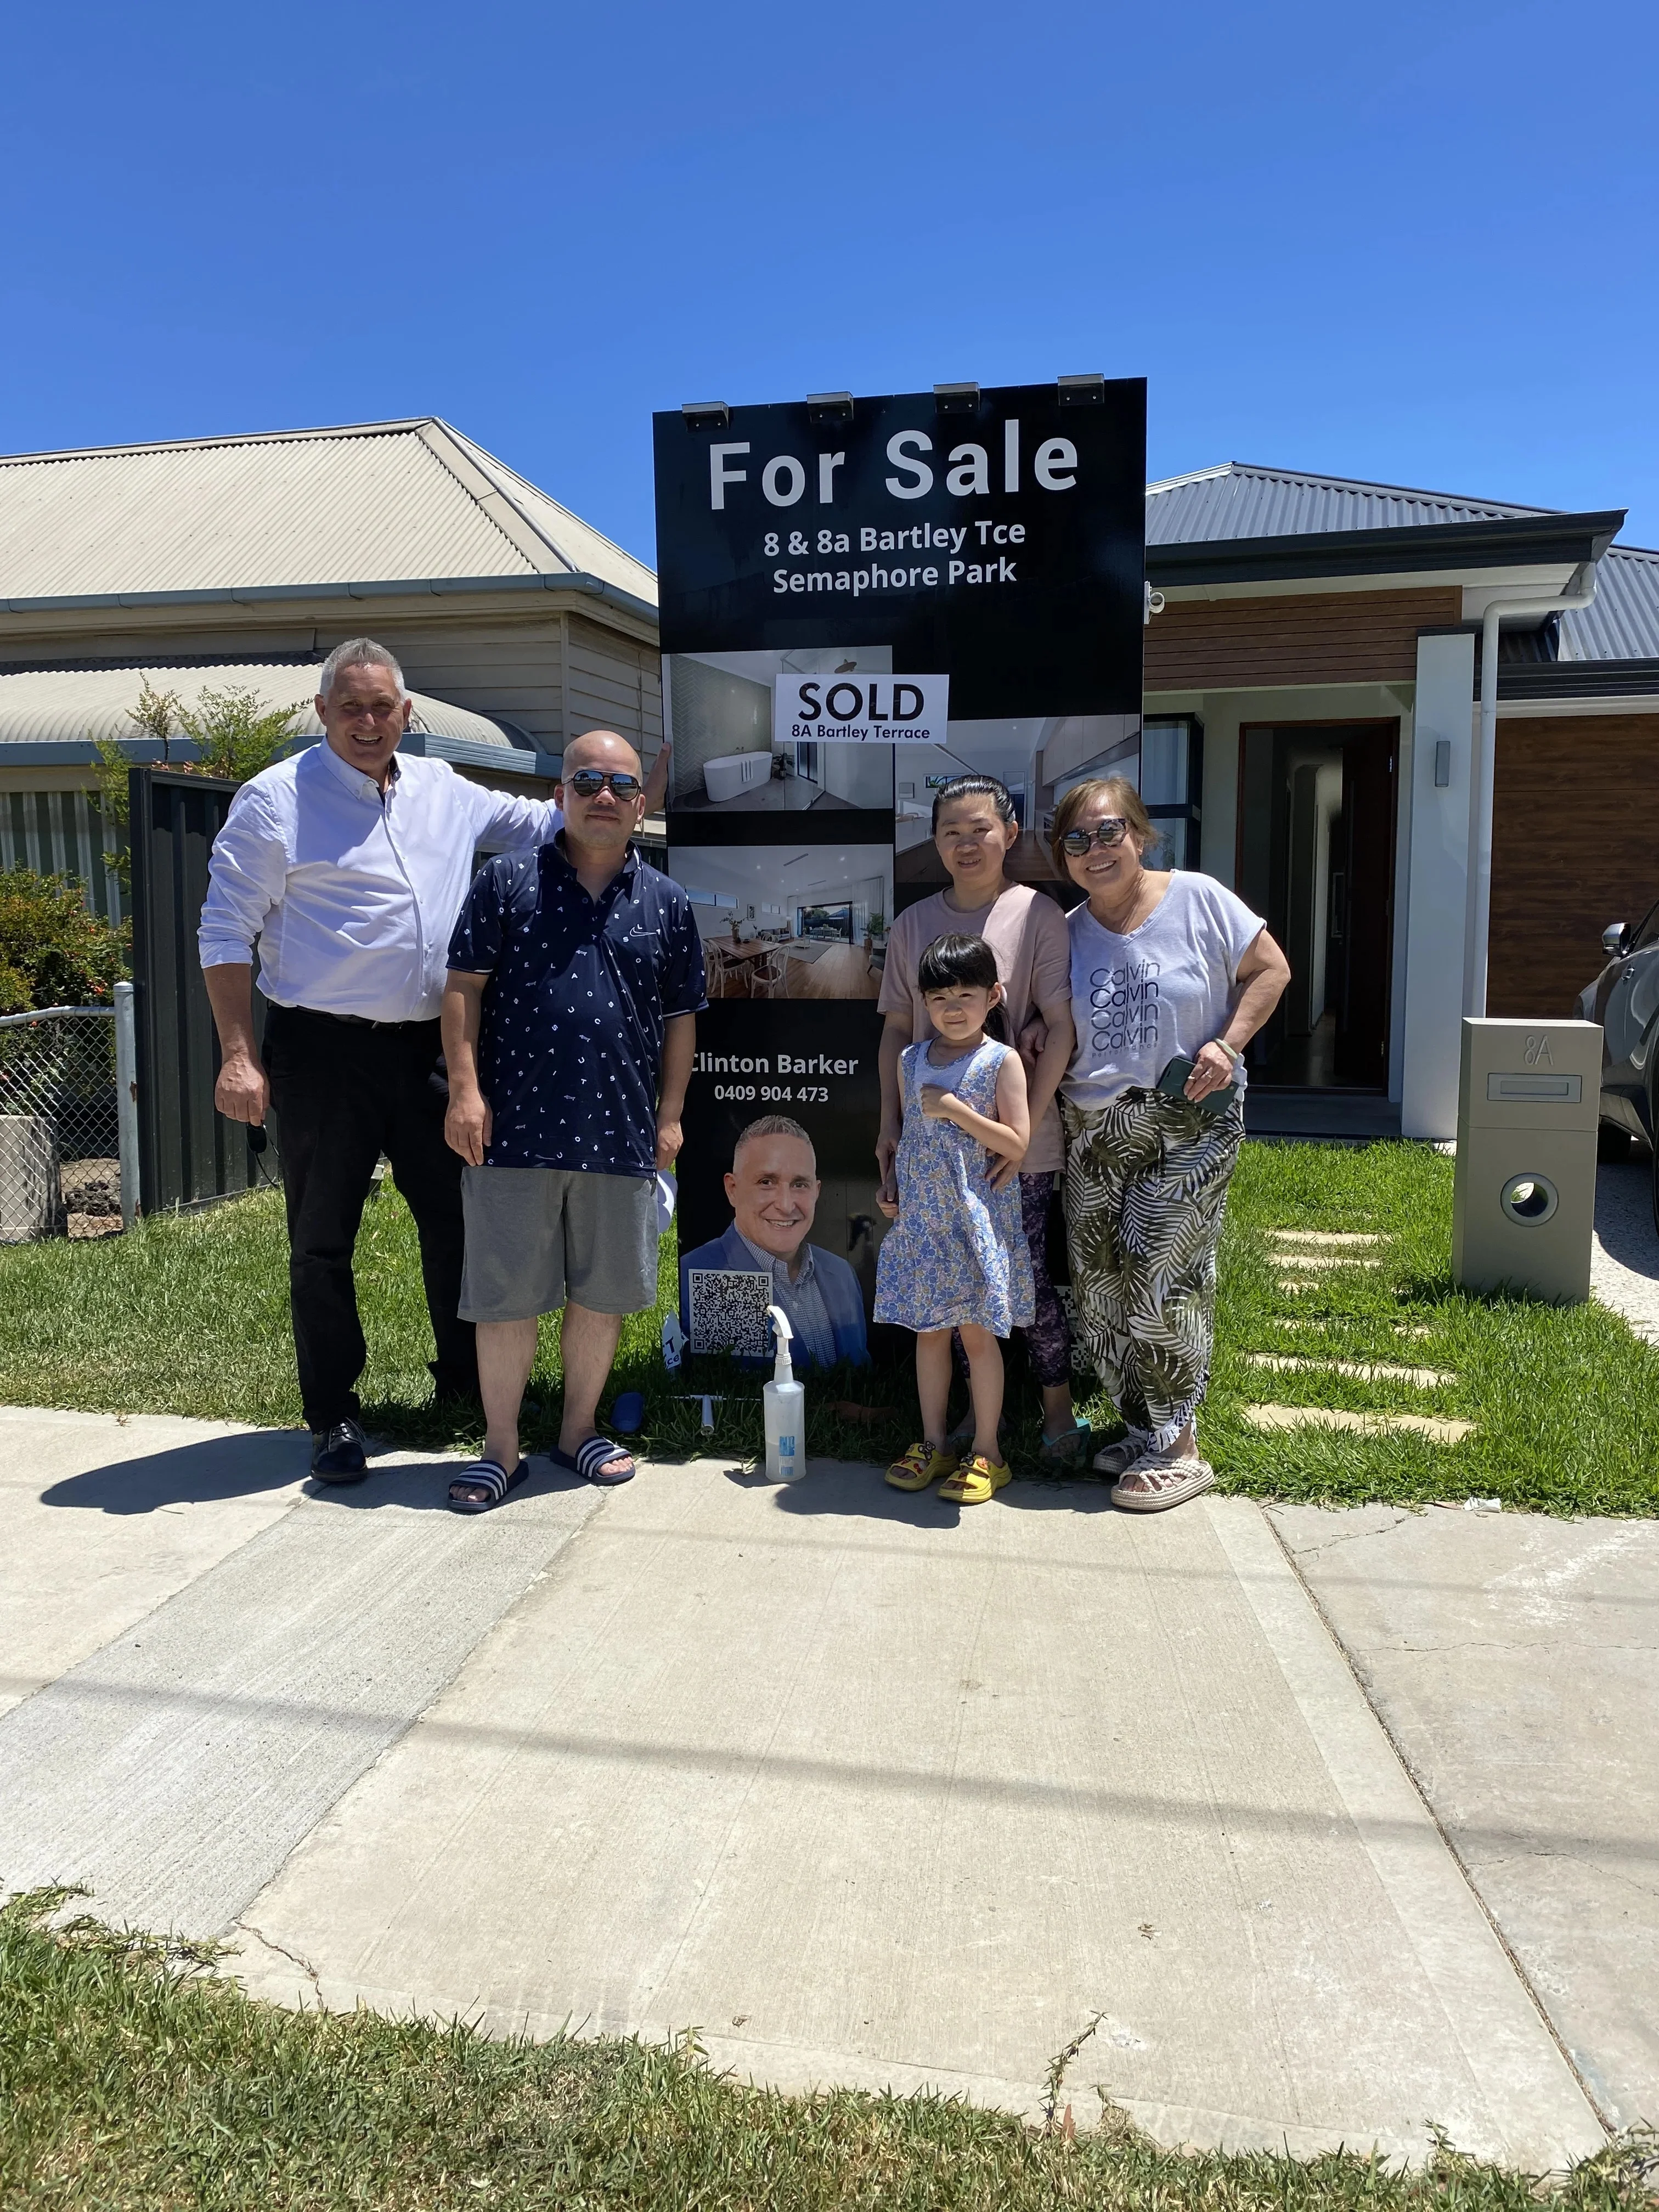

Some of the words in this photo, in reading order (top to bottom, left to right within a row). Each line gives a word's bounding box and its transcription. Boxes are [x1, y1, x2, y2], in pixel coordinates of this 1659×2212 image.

[709, 441, 845, 510] For
[885, 419, 1078, 500] Sale
[763, 532, 780, 556] 8
[788, 531, 810, 555] &
[816, 529, 849, 554] 8a
[860, 522, 967, 554] Bartley
[974, 520, 1025, 545] Tce
[773, 563, 938, 597] Semaphore
[949, 556, 1017, 584] Park
[798, 682, 924, 721] SOLD
[791, 724, 812, 737] 8A
[817, 724, 868, 741] Bartley
[873, 725, 930, 738] Terrace
[1090, 959, 1160, 988] Calvin
[1090, 979, 1159, 1009] Calvin
[1091, 1000, 1158, 1030] Calvin
[1092, 1023, 1158, 1052] Calvin
[1523, 1034, 1554, 1065] 8A
[777, 1054, 859, 1075] Barker
[714, 1085, 756, 1101] 0409
[760, 1086, 792, 1101] 904
[797, 1087, 829, 1102] 473
